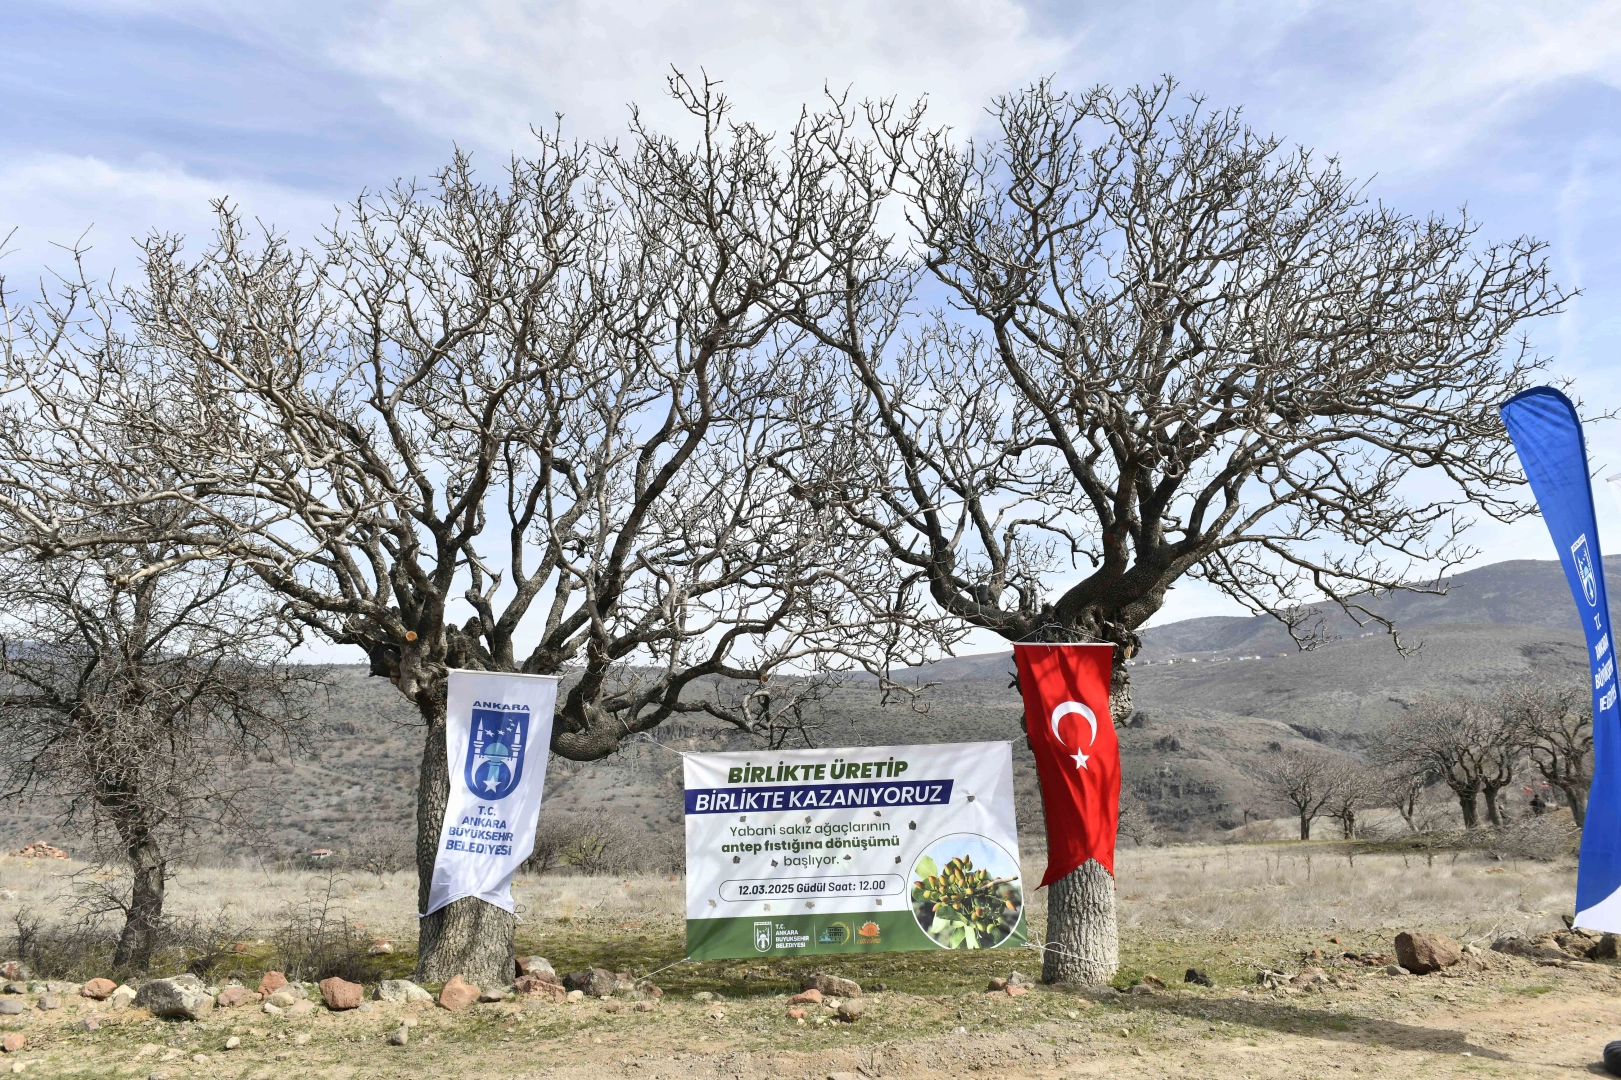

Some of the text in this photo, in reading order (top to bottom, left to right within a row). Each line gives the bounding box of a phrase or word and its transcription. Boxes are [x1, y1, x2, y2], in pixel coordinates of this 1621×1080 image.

[473, 700, 530, 711] ANKARA
[727, 756, 909, 784] BİRLİKTE ÜRETİP
[695, 785, 943, 812] BİRLİKTE KAZANIYORUZ
[478, 805, 496, 816] T.C.
[461, 816, 507, 829] ANKARA
[729, 821, 891, 837] Yabani sakız ağaçlarının
[448, 826, 514, 842] BÜYÜKŞEHİR
[445, 839, 513, 856] BELEDİYESİ
[721, 835, 900, 855] antep fıstığına dönüşümü
[783, 854, 840, 869] başlıyor.
[738, 879, 886, 896] 12.03.2025 Güdül Saat: 12.00
